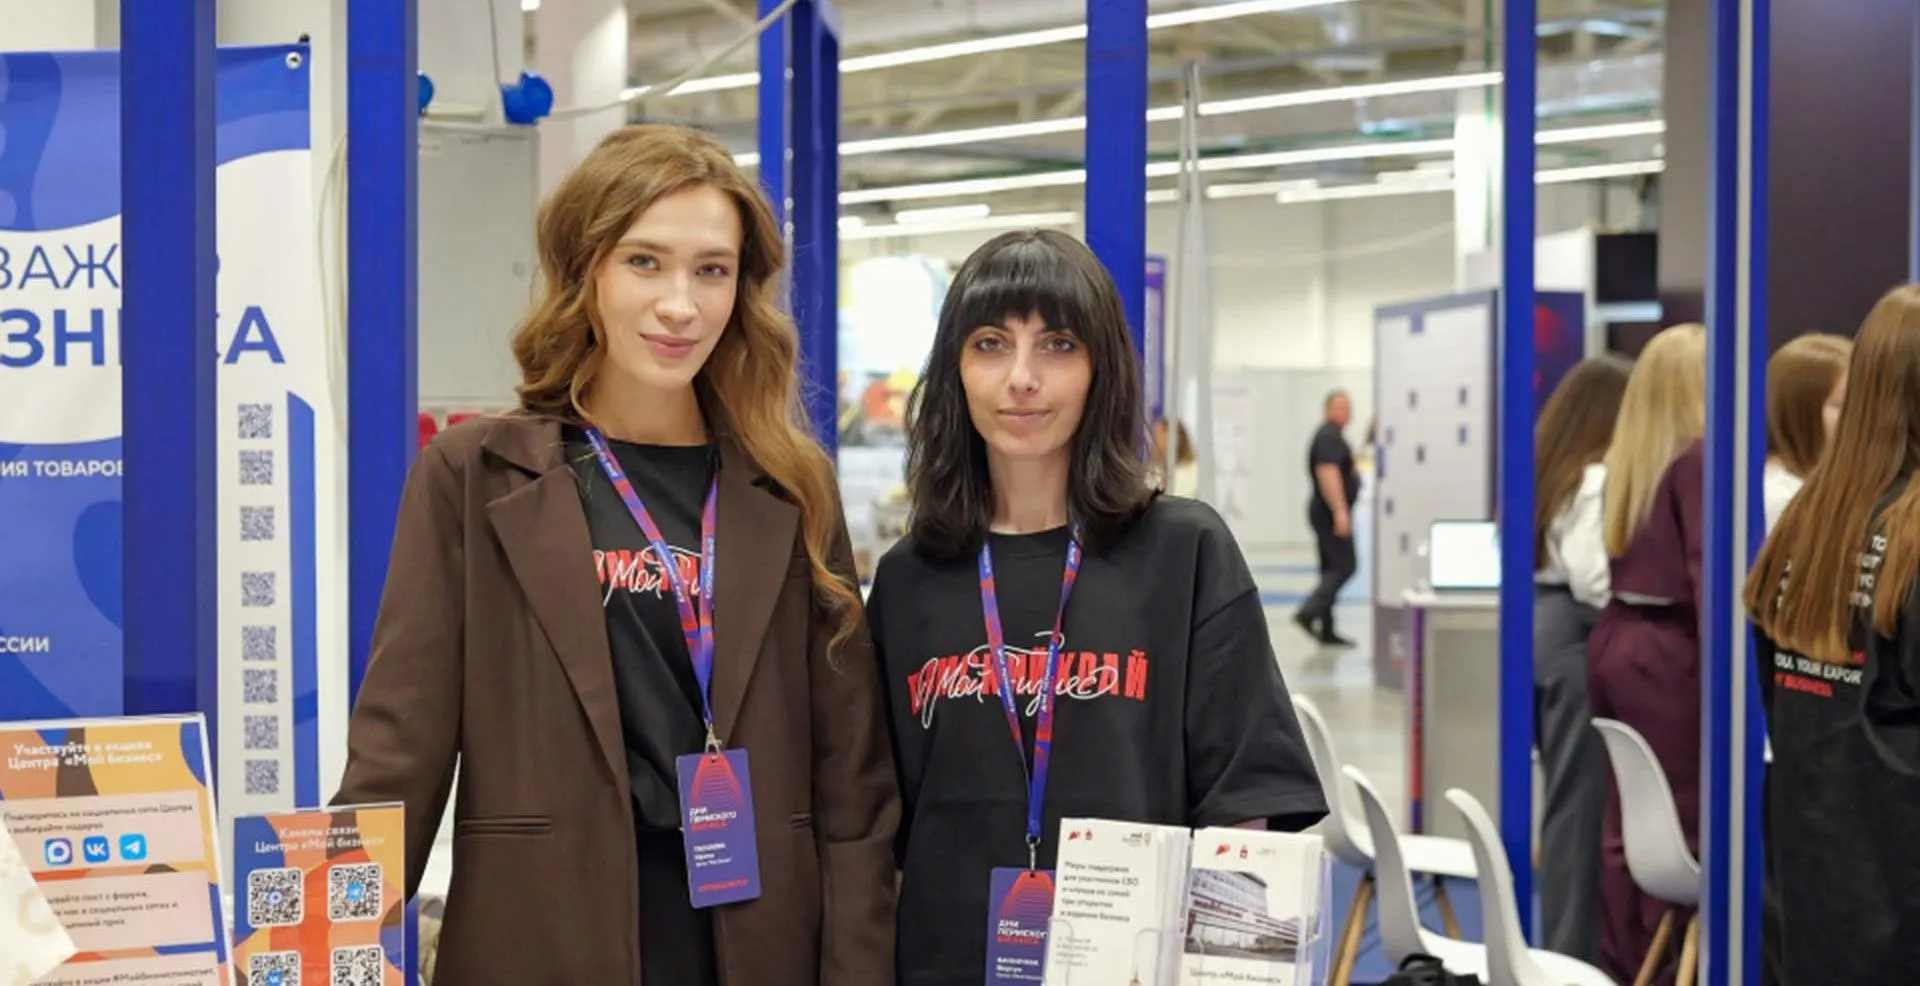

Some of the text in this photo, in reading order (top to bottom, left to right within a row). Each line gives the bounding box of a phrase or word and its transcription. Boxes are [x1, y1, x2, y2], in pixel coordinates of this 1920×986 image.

[0, 306, 287, 368] ЗНА
[8, 753, 60, 771] Центра
[255, 841, 299, 854] Центра
